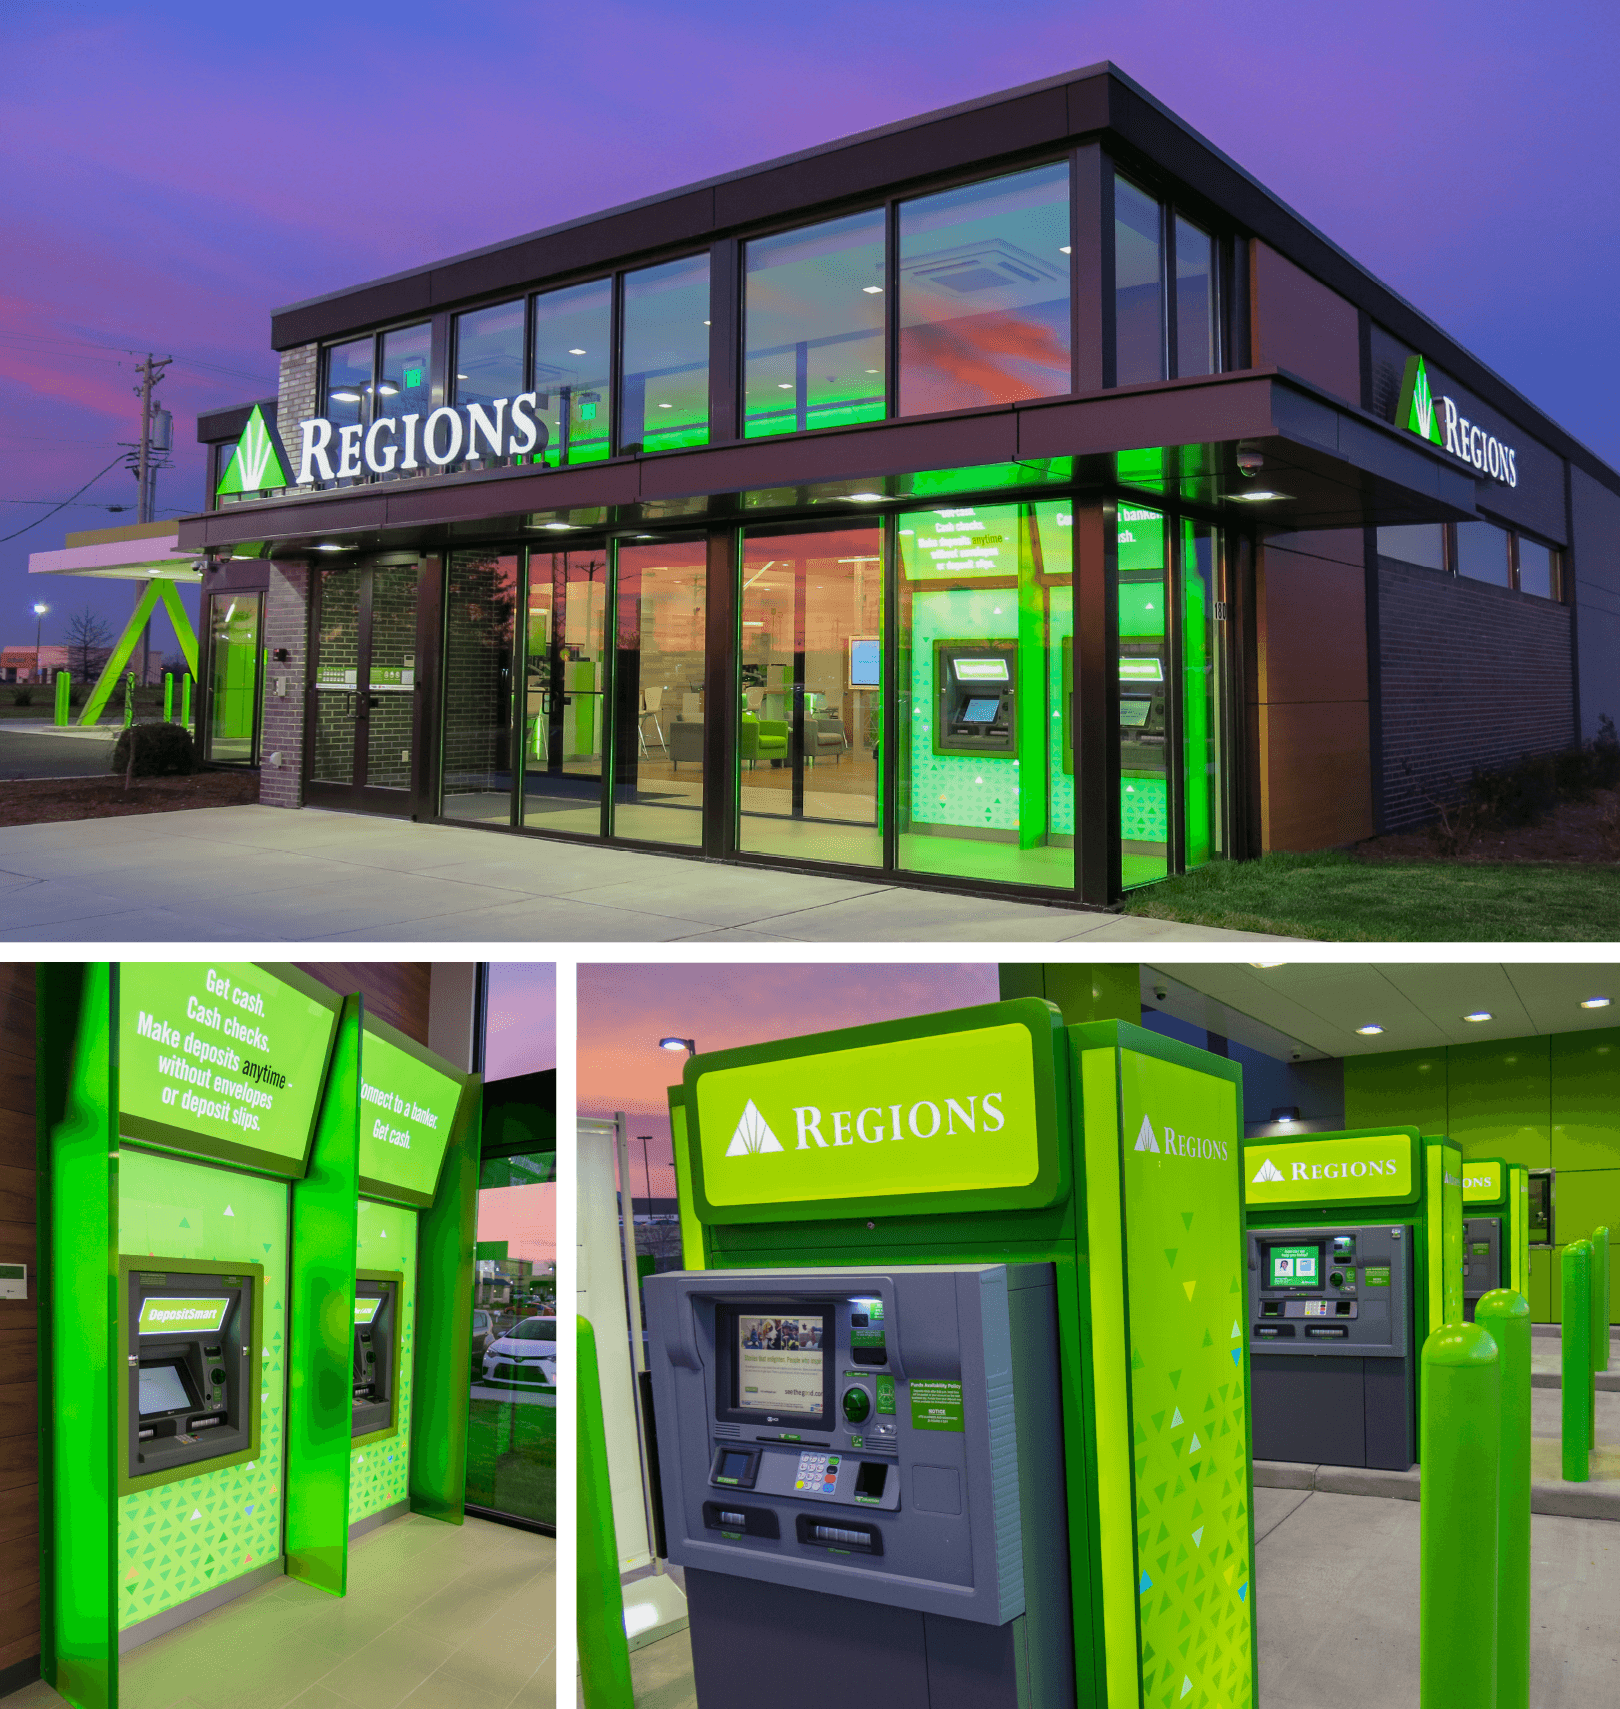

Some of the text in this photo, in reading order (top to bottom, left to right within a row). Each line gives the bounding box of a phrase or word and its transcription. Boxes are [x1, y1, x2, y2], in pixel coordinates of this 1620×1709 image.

[296, 391, 537, 484] REGIONS
[1443, 395, 1517, 488] REGIONS
[972, 534, 1003, 545] anytime
[206, 968, 265, 1018] Get cash.
[137, 1010, 180, 1048] Make
[183, 1032, 240, 1072] deposits
[242, 1059, 286, 1089] anytime
[187, 996, 270, 1053] Cash checks.
[158, 1054, 273, 1110] without envelopes
[361, 1077, 438, 1130] onnect to a banker.
[162, 1086, 261, 1132] or deposit slips.
[373, 1119, 411, 1149] Get cash.
[792, 1092, 1005, 1150] REGIONS
[1163, 1126, 1228, 1161] REGIONS
[1290, 1159, 1397, 1181] REGIONS
[148, 1308, 217, 1323] DepositSmart
